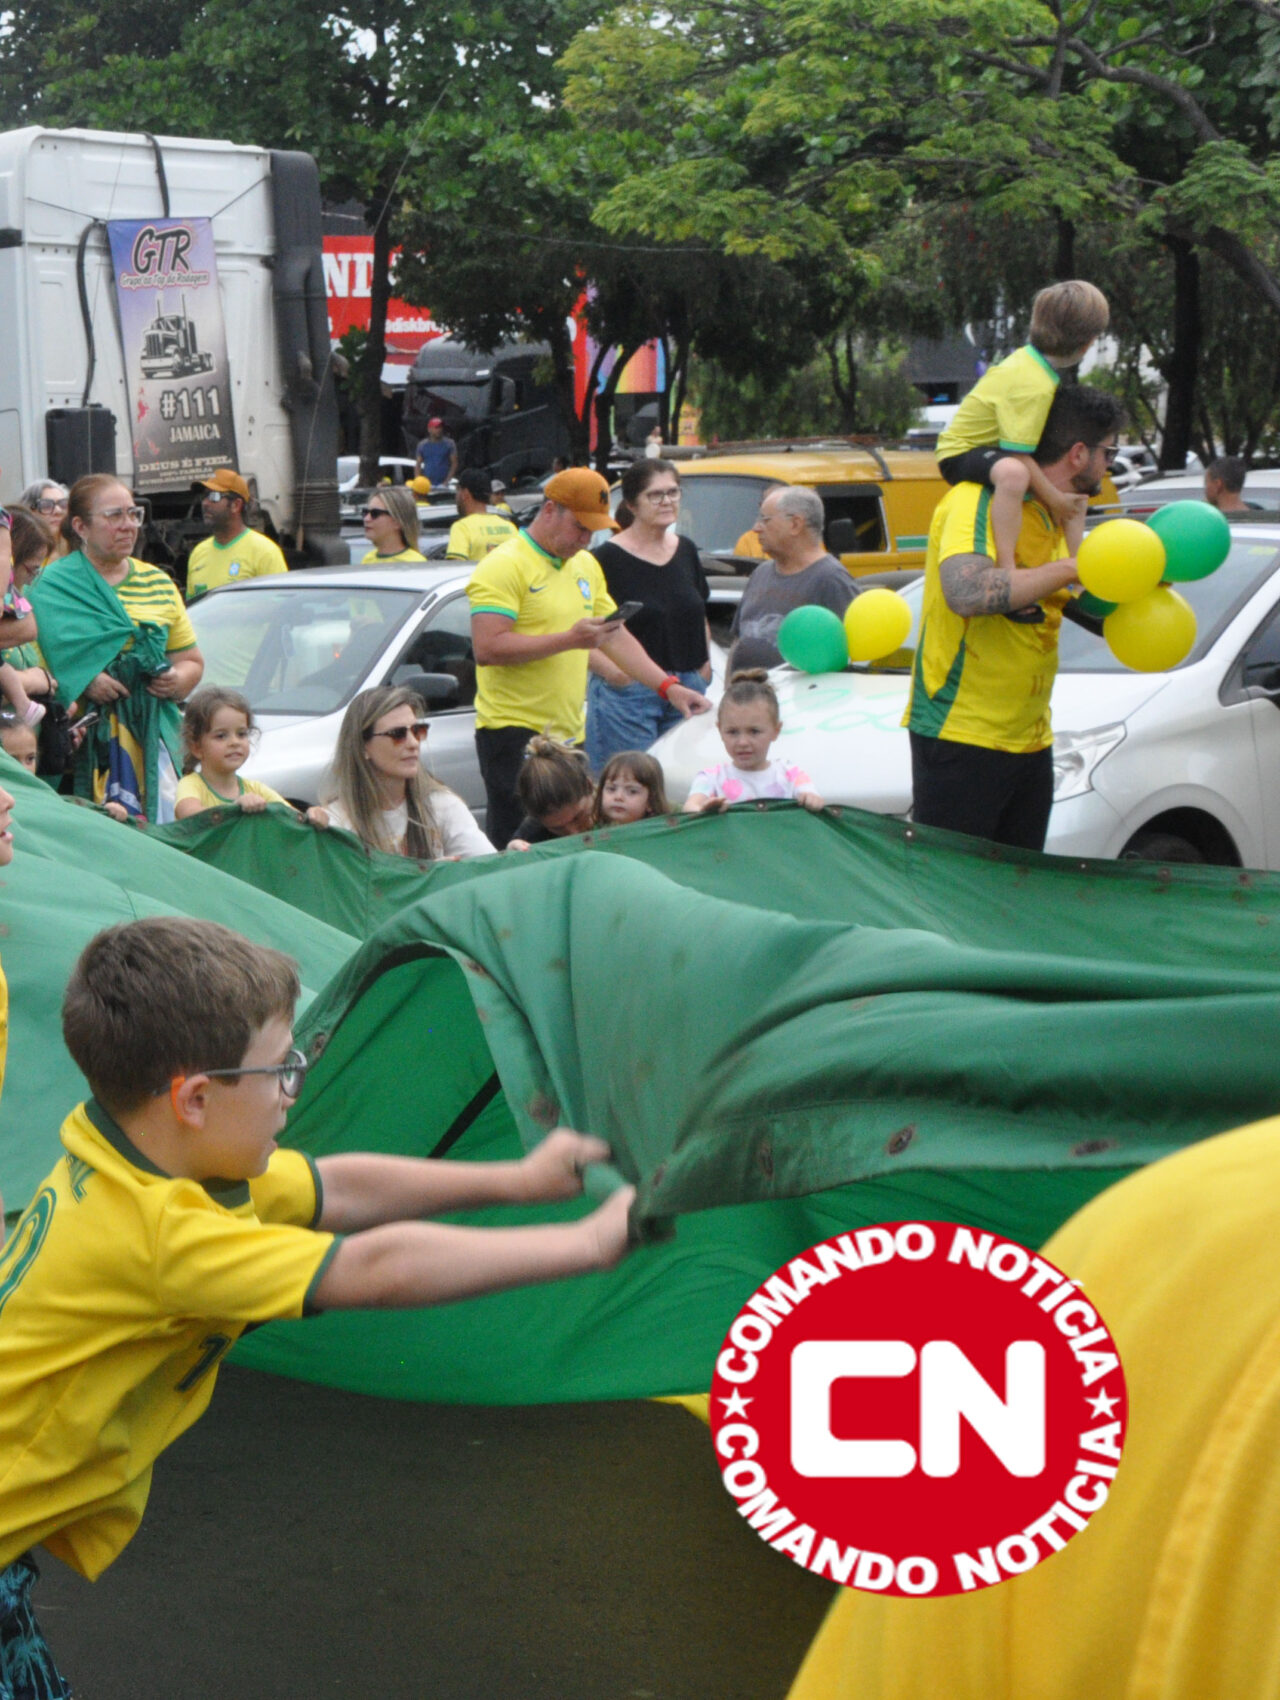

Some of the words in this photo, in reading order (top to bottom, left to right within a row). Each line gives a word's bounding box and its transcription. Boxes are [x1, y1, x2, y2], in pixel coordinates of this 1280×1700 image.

[132, 226, 191, 274] GTR
[160, 385, 221, 420] #111
[170, 423, 221, 443] JAMAICA
[138, 459, 179, 473] DEUS
[195, 454, 233, 467] FIEL
